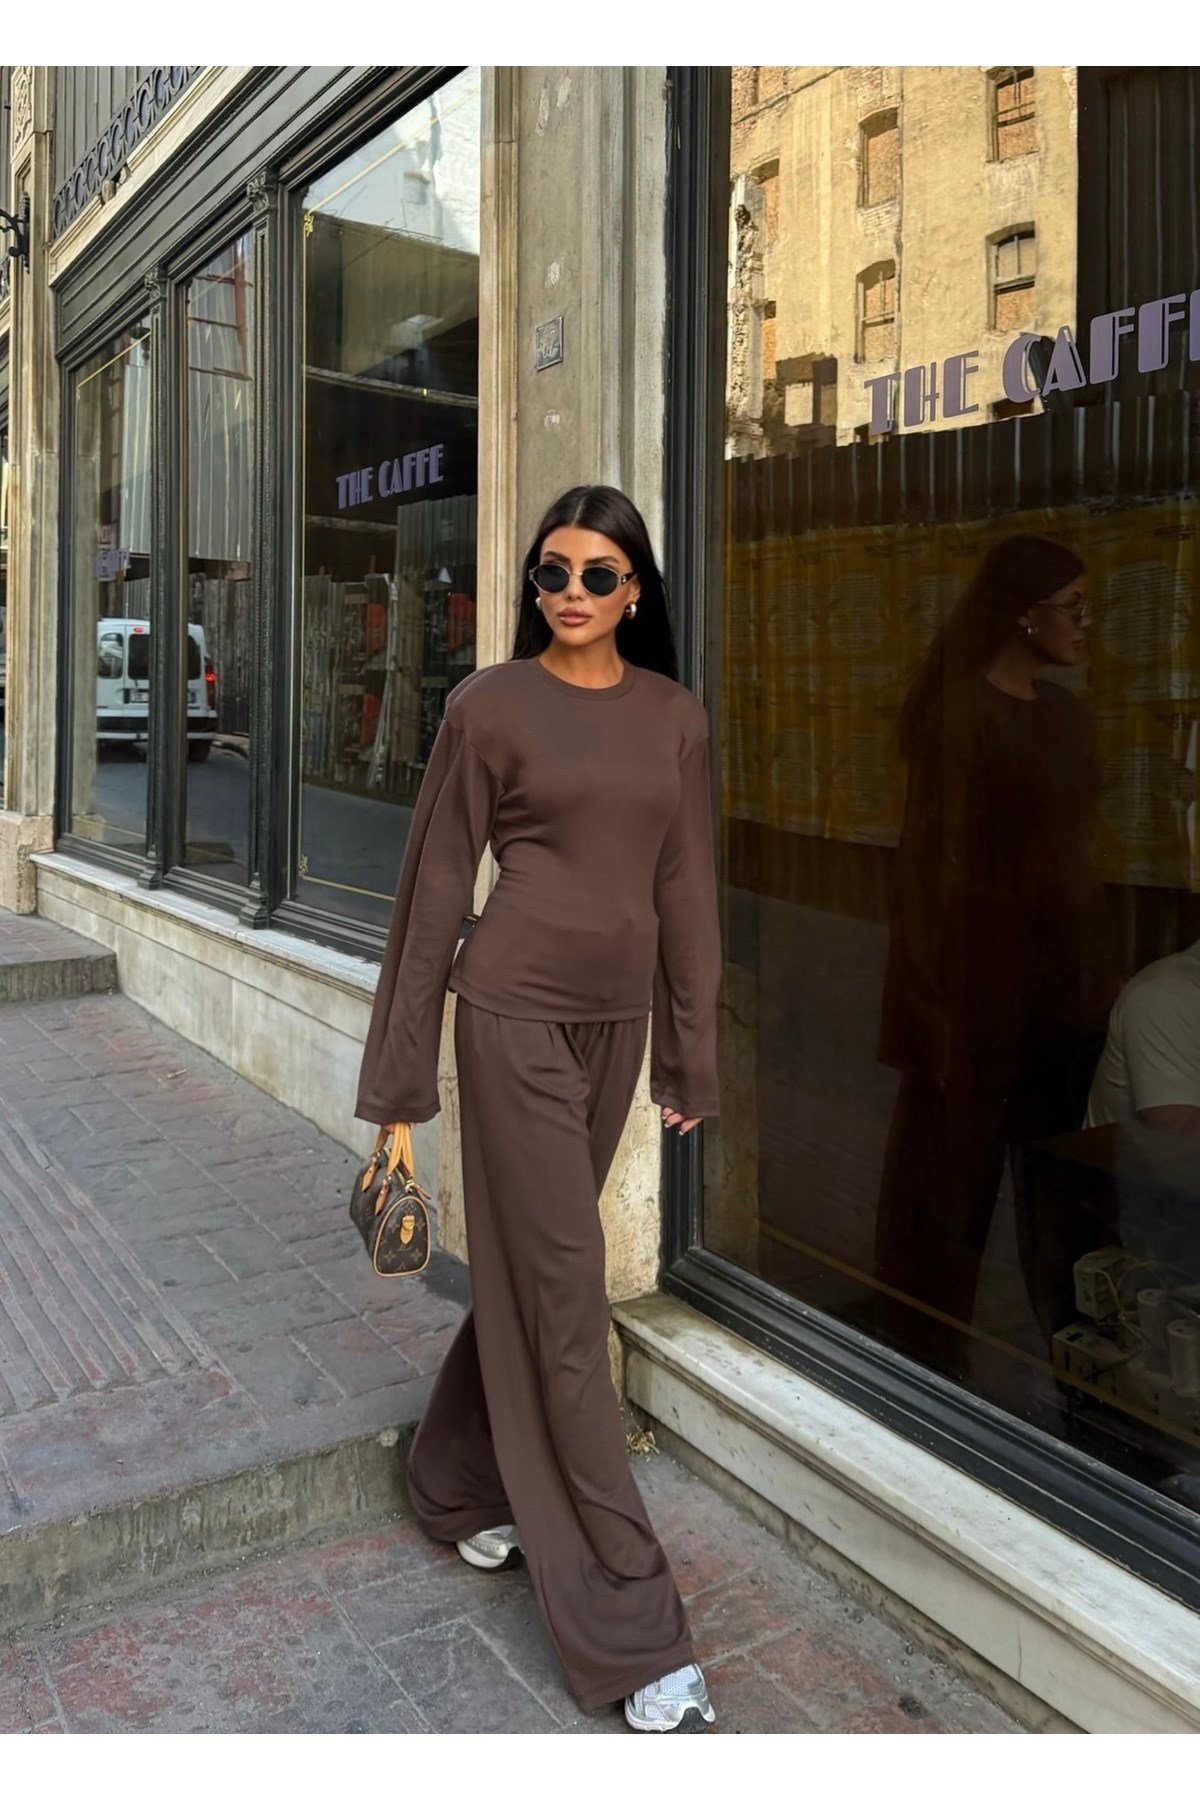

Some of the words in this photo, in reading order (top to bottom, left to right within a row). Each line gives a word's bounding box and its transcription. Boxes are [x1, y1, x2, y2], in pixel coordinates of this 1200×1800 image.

[864, 350, 979, 436] THE
[1002, 289, 1200, 403] CAFF
[336, 466, 373, 509] THE
[378, 444, 443, 498] CAFFE
